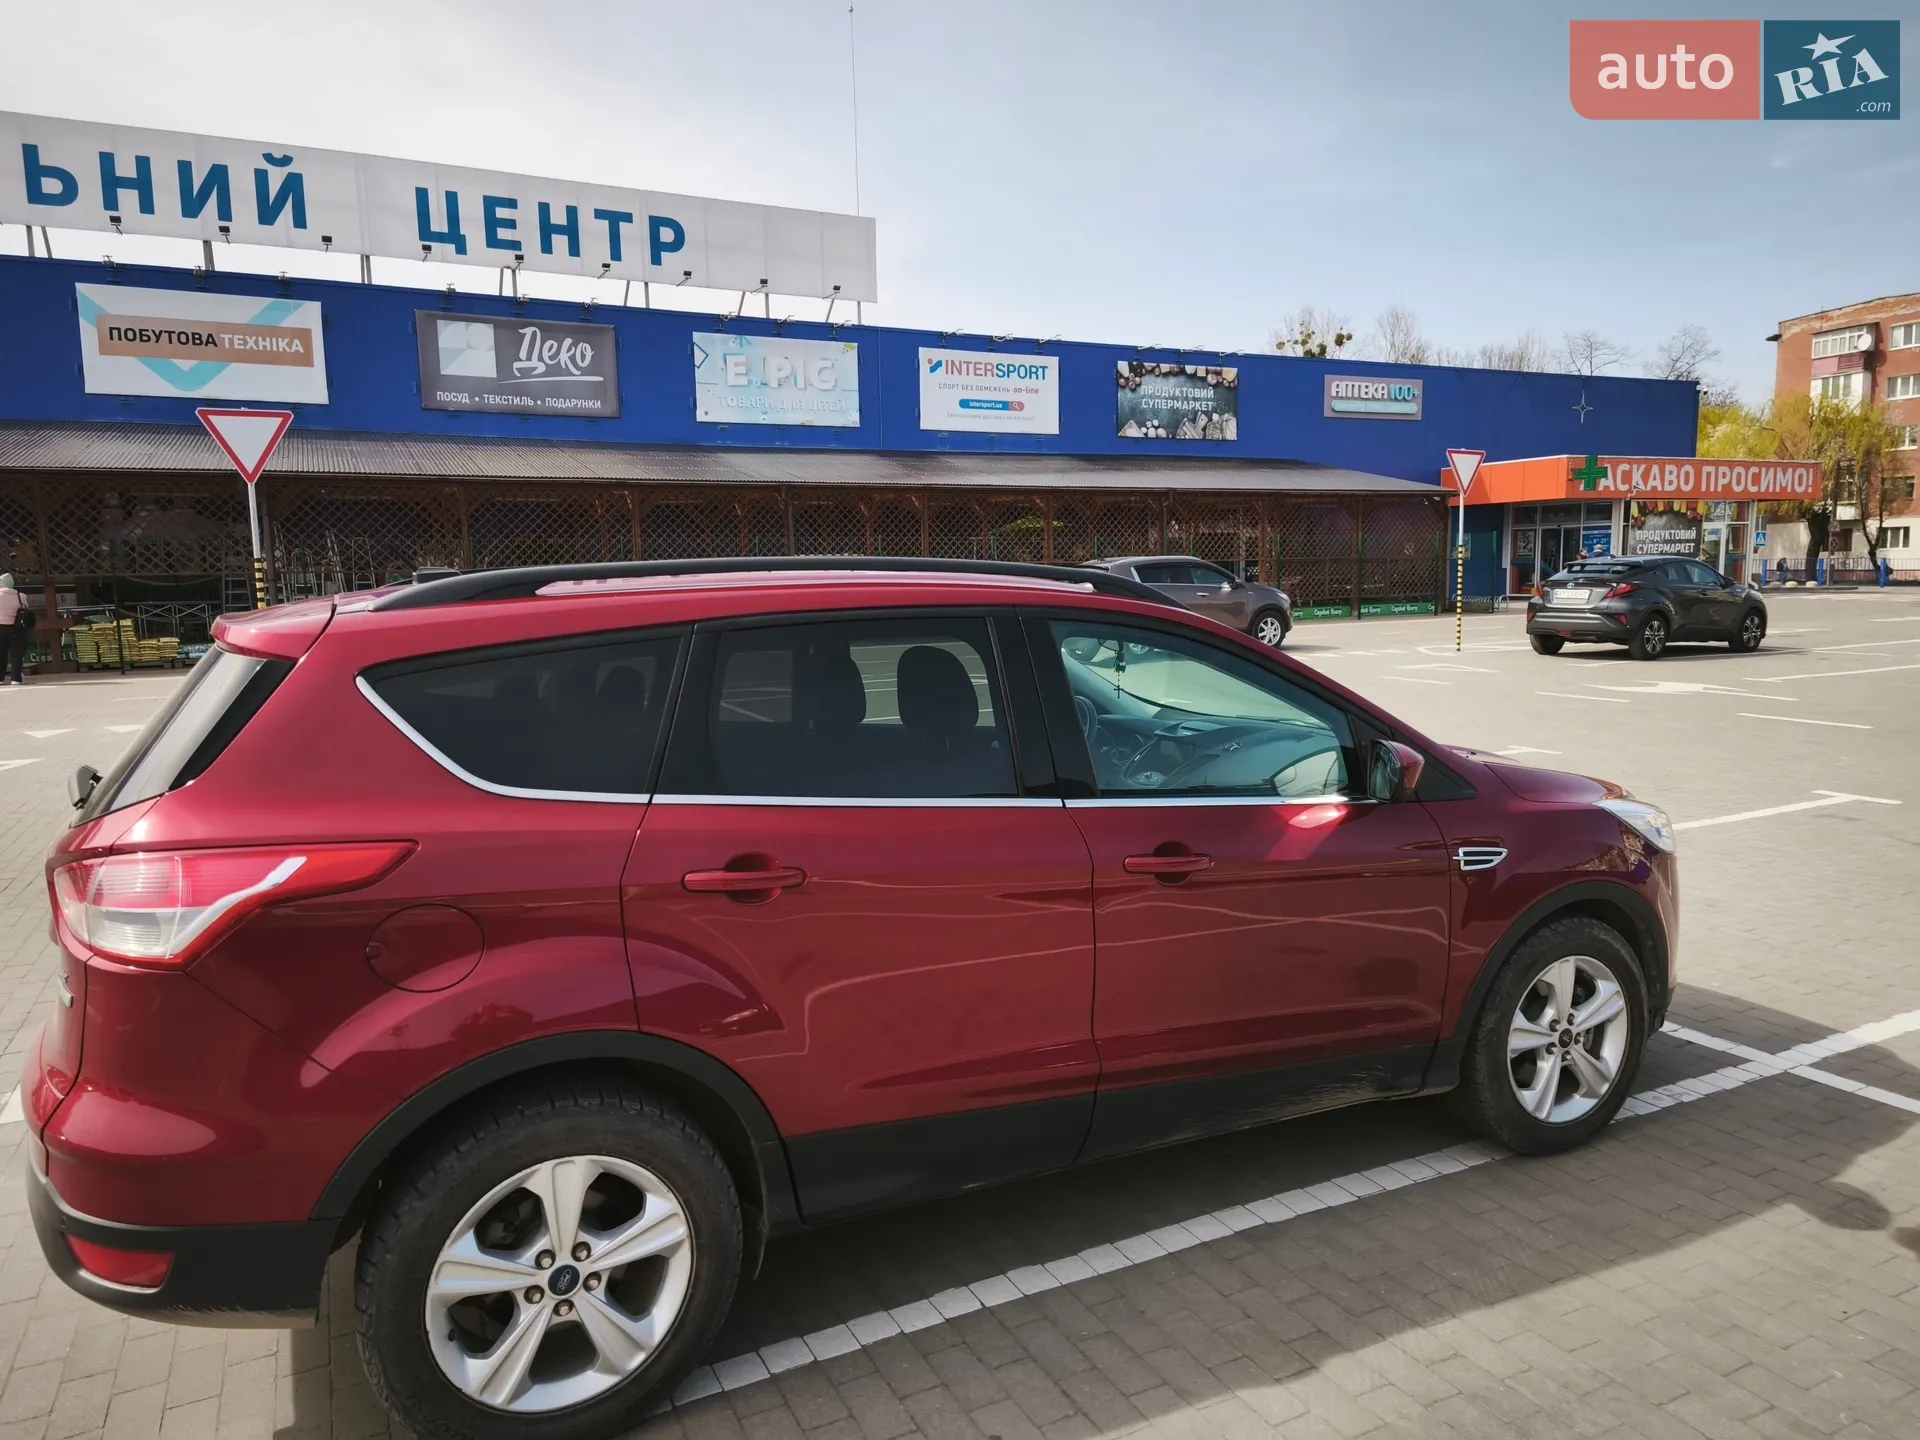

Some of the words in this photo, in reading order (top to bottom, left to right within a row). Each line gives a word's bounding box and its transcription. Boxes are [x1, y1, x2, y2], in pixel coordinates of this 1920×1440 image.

[21, 143, 308, 230] ЬНИЙ
[414, 186, 687, 267] ЦЕНТР
[108, 326, 219, 348] ПОБУТОВА
[220, 333, 305, 354] ТЕХНІКА
[512, 326, 595, 377] Деко
[944, 359, 1049, 381] INTERSPORT
[938, 382, 960, 391] СПОРТ
[961, 384, 974, 392] БЕЗ
[975, 384, 1011, 393] ОБМЕЖЕНЬ
[1013, 385, 1040, 395] on-line
[1141, 385, 1215, 400] ПРОДУКТОВИЙ
[1330, 381, 1388, 400] АПТЕКА
[436, 391, 470, 404] ПОСУД
[482, 393, 535, 406] ТЕКСТИЛЬ
[545, 396, 602, 409] ПОДАРУНКИ
[718, 396, 775, 409] ТОВАРИ
[1141, 398, 1214, 411] СУПЕРМАРКЕТ
[1580, 463, 1695, 492] АСКАВО
[1700, 465, 1814, 494] ПРОСИМО!
[1636, 526, 1697, 542] ПРОДУКТОВИЙ
[1636, 543, 1696, 555] СУПЕРМАРКЕТ
